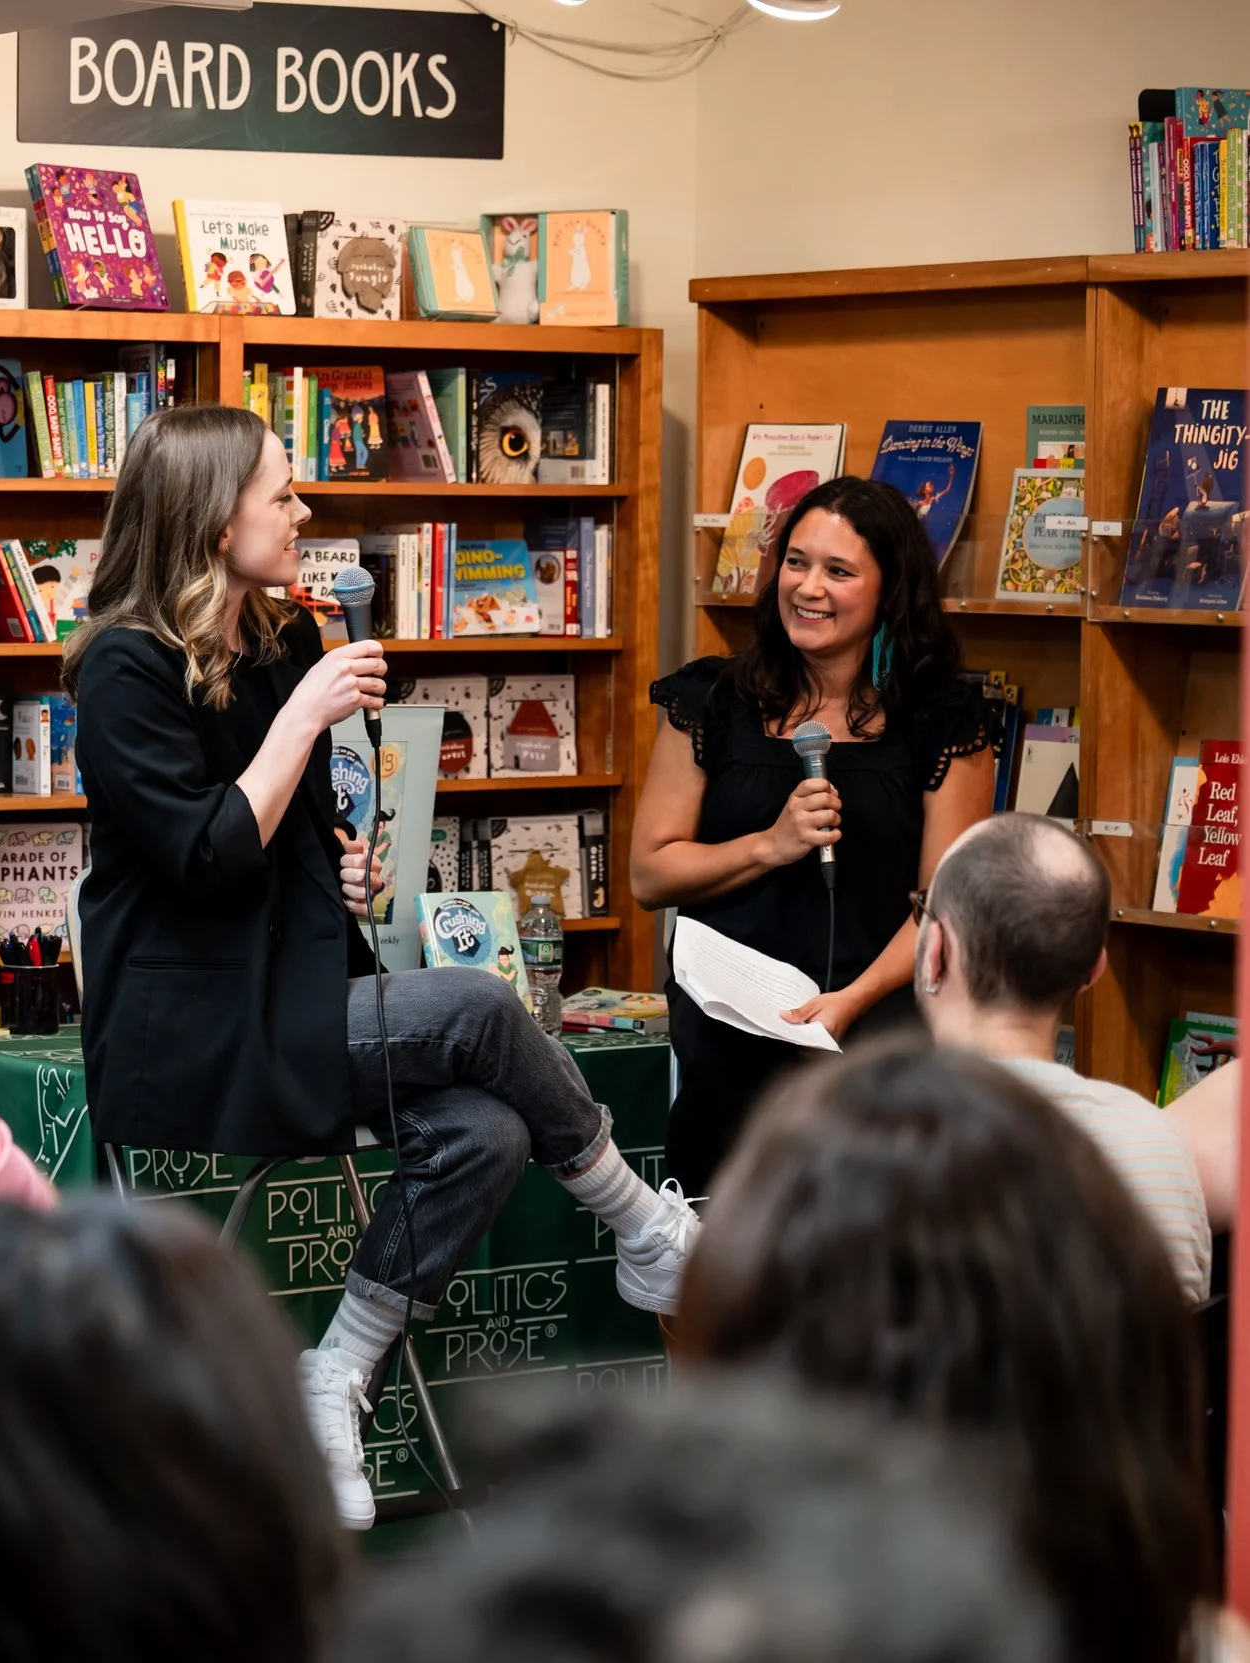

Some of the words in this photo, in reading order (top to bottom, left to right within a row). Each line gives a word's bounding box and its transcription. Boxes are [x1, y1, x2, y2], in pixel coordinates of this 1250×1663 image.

[69, 37, 251, 111] BOARD
[276, 47, 457, 119] BOOKS
[67, 207, 91, 220] How
[93, 209, 105, 223] To
[107, 211, 129, 230] Say
[202, 220, 233, 235] Let's
[238, 222, 269, 236] Make
[63, 222, 147, 258] HELLO
[220, 237, 257, 251] Music
[1032, 414, 1085, 425] MARIANTH
[1201, 399, 1230, 420] THE
[908, 424, 933, 433] DEBBIE
[935, 425, 958, 434] ALLEN
[881, 435, 919, 455] Dancing
[920, 438, 930, 449] in
[931, 436, 946, 449] the
[947, 436, 975, 458] Wings
[1034, 527, 1057, 538] PEAR
[301, 549, 311, 560] A
[315, 551, 357, 563] BEARD
[455, 550, 503, 565] DINO-
[302, 572, 327, 583] LIKE
[455, 564, 526, 581] WIMMING
[320, 586, 337, 598] DA
[1214, 752, 1230, 763] Lois
[331, 761, 370, 795] shing
[1209, 781, 1237, 801] Red
[1206, 803, 1239, 827] Leaf,
[1203, 825, 1243, 846] Yellow
[51, 851, 67, 863] OF
[1198, 847, 1231, 867] Leaf
[22, 909, 64, 918] HENKES
[434, 909, 487, 940] Crushing
[454, 928, 475, 952] It
[129, 1148, 233, 1190] PROSE
[327, 1225, 357, 1239] AND
[288, 1239, 362, 1283] PRO
[443, 1269, 568, 1318] OLITICS
[485, 1317, 511, 1331] AND
[577, 1363, 665, 1399] POLIT
